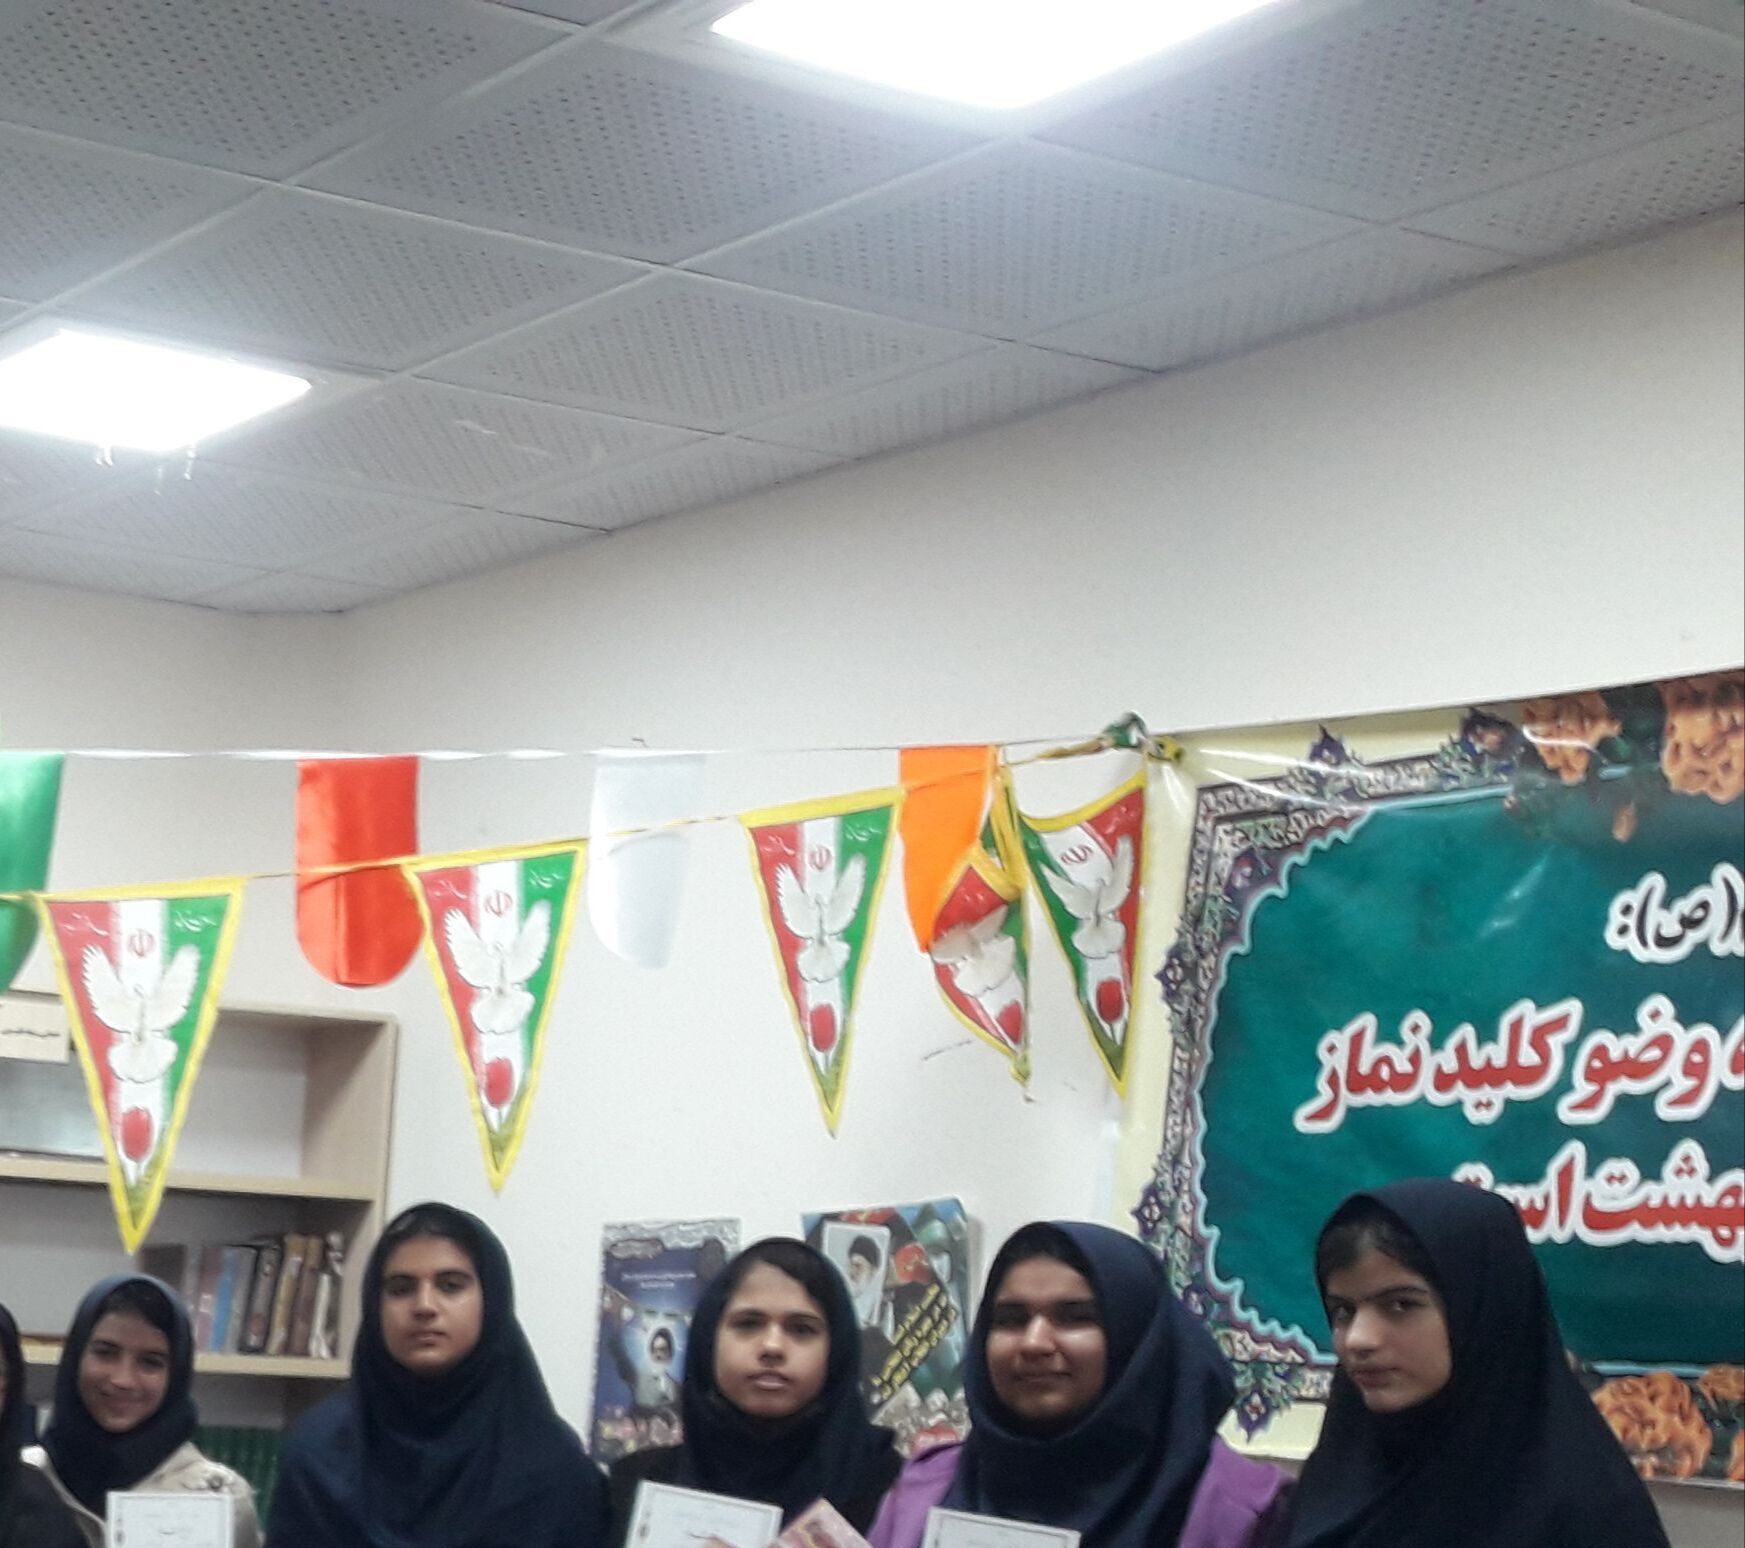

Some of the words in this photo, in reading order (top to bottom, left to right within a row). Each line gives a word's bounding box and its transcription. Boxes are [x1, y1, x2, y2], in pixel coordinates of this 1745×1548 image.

[1302, 1019, 1425, 1124] نماز
[1430, 1009, 1572, 1113] کلید
[1565, 1005, 1715, 1113] وضو
[1460, 1151, 1578, 1232] اس
[1580, 1149, 1745, 1250] هشت
